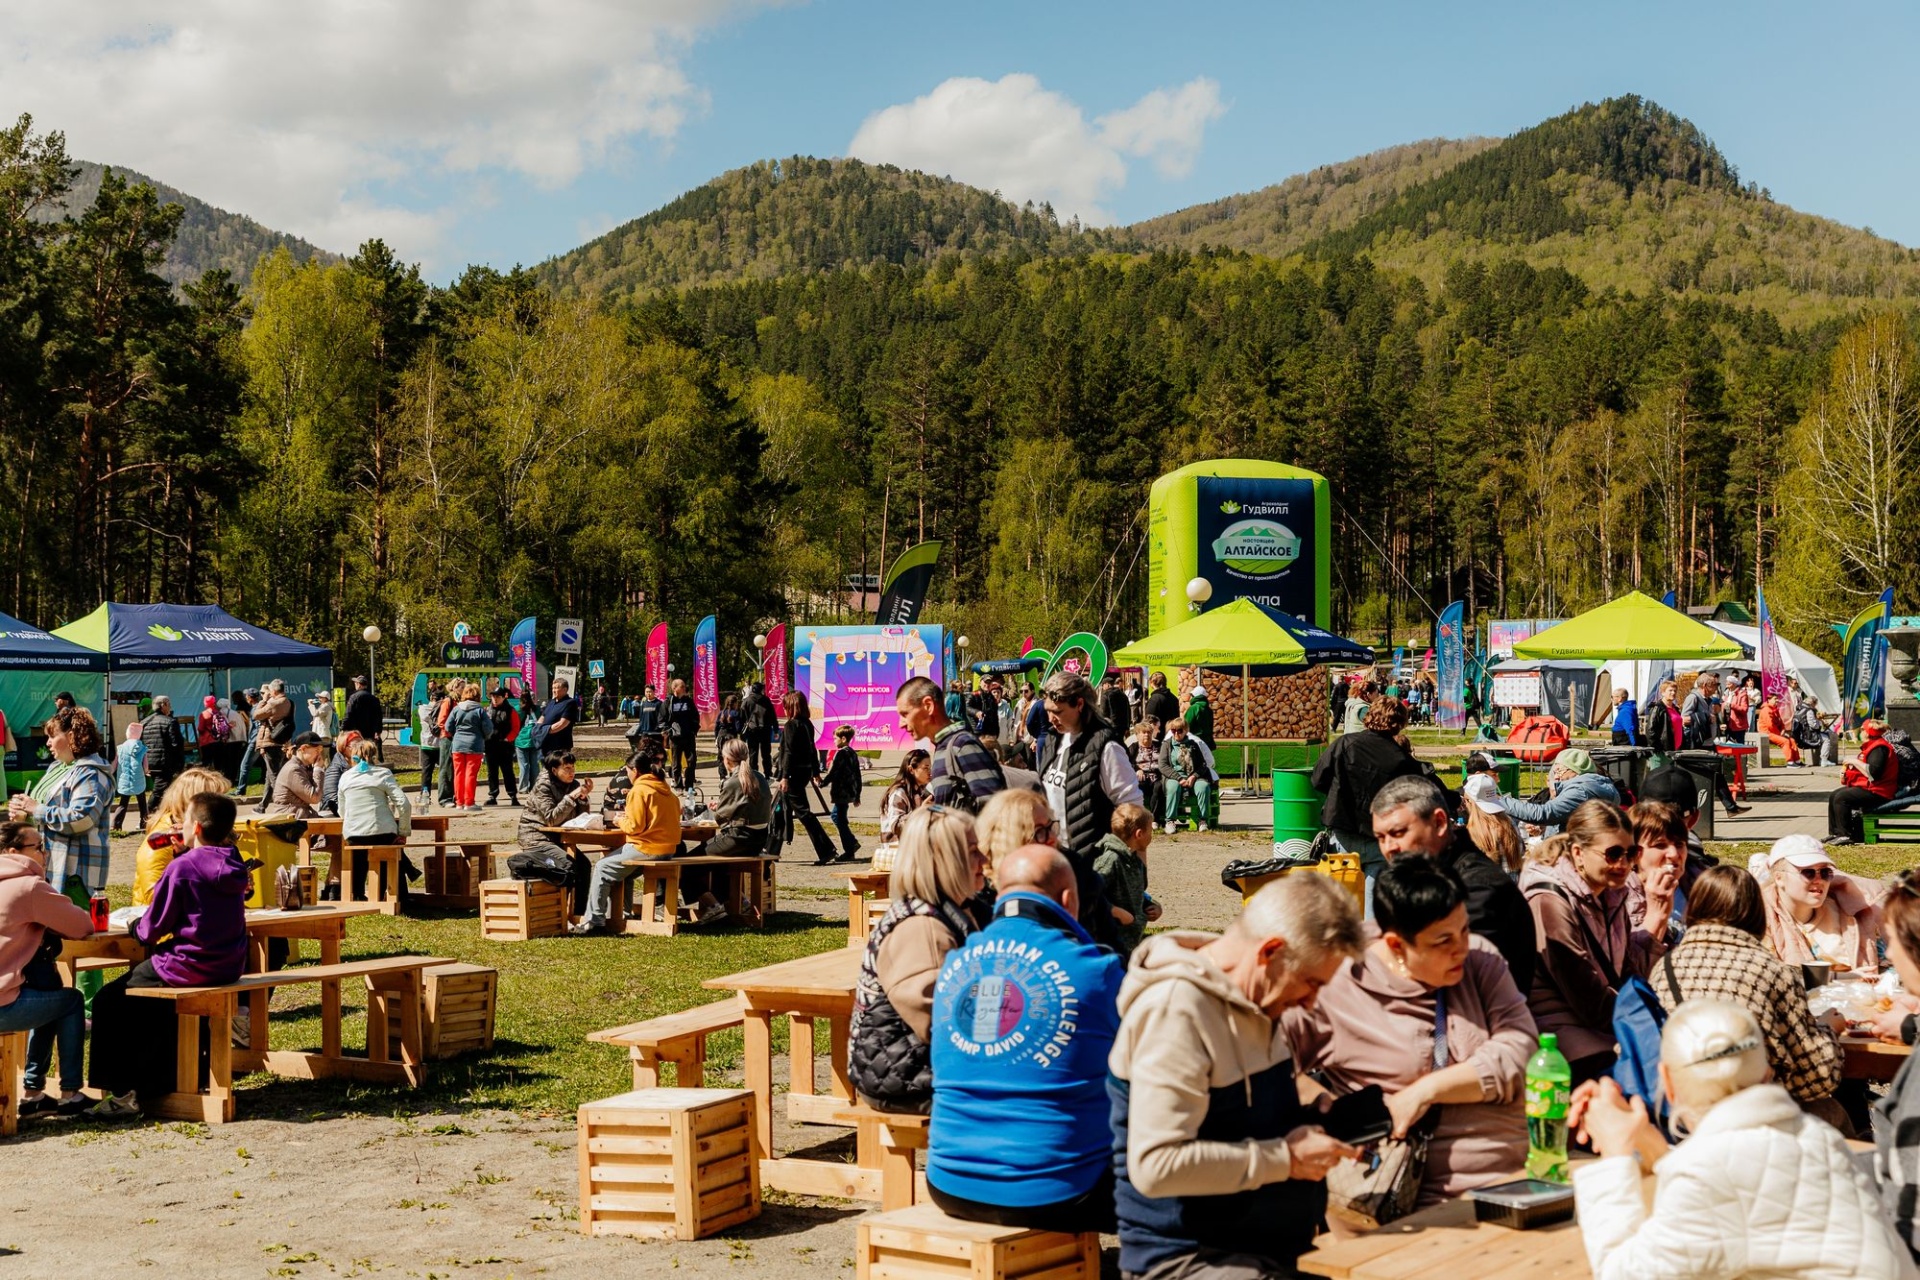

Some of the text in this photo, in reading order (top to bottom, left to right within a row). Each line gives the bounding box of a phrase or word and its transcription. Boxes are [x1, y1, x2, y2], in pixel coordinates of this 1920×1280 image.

[1242, 504, 1289, 515] Гудвилл
[1224, 544, 1292, 556] АЛТАЙСКОЕ
[181, 629, 255, 642] Гудвилл
[462, 648, 494, 659] Гудвилл
[525, 640, 533, 689] РАЛЬНИКА
[1860, 637, 1872, 692] Гудвилл
[707, 641, 716, 698] МАРАЛЬНИКА
[970, 984, 1011, 998] BLUE
[993, 958, 1049, 1020] SAILING
[937, 939, 1079, 1068] AUSTRALIAN CHALLENGE
[950, 1031, 1025, 1056] CAMP DAVID
